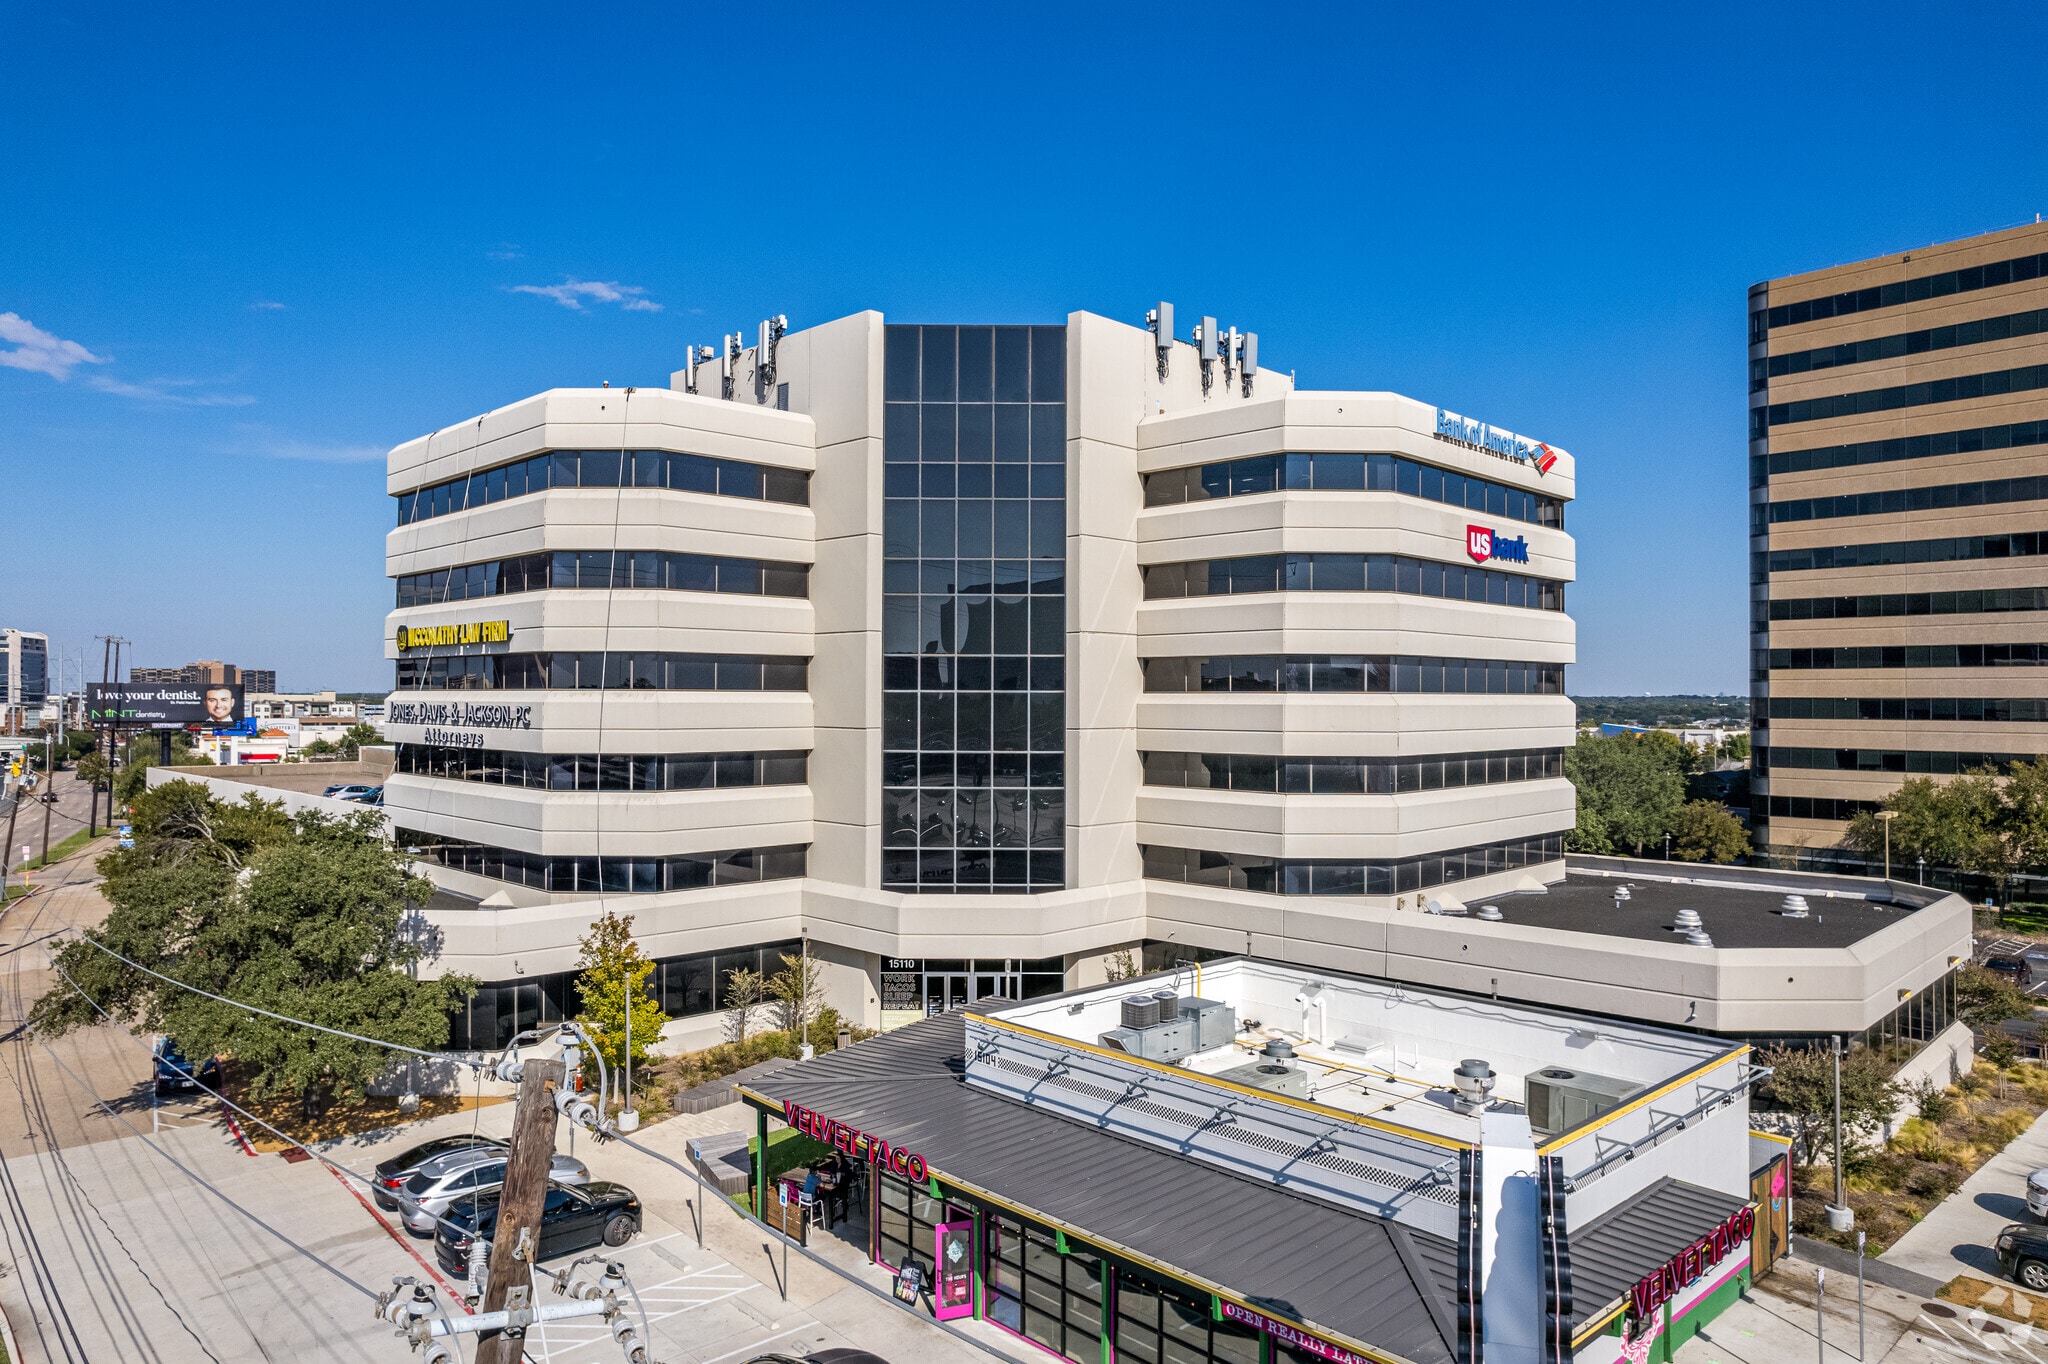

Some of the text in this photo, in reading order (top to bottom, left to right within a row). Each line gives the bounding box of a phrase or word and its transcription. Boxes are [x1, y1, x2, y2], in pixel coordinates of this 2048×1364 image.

[1437, 408, 1529, 461] Bank of America
[460, 622, 481, 644] LAW
[482, 620, 508, 643] FIRM
[125, 692, 154, 703] your
[156, 689, 201, 700] dentist.
[136, 710, 165, 719] dentistry
[389, 702, 531, 727] JONES, DAVIS & JACKSON, PC
[424, 727, 484, 747] Attorneys
[888, 959, 915, 969] 15110
[883, 974, 916, 983] WORK
[883, 983, 916, 992] TACOS
[883, 991, 914, 1001] SLEEP
[883, 1001, 920, 1010] REPEAT
[974, 1050, 997, 1067] 15104
[783, 1099, 929, 1183] VELVET TACO
[1632, 1206, 1756, 1320] VELVET TACO
[1226, 1303, 1264, 1331] OPEN
[1267, 1322, 1328, 1353] REALLY
